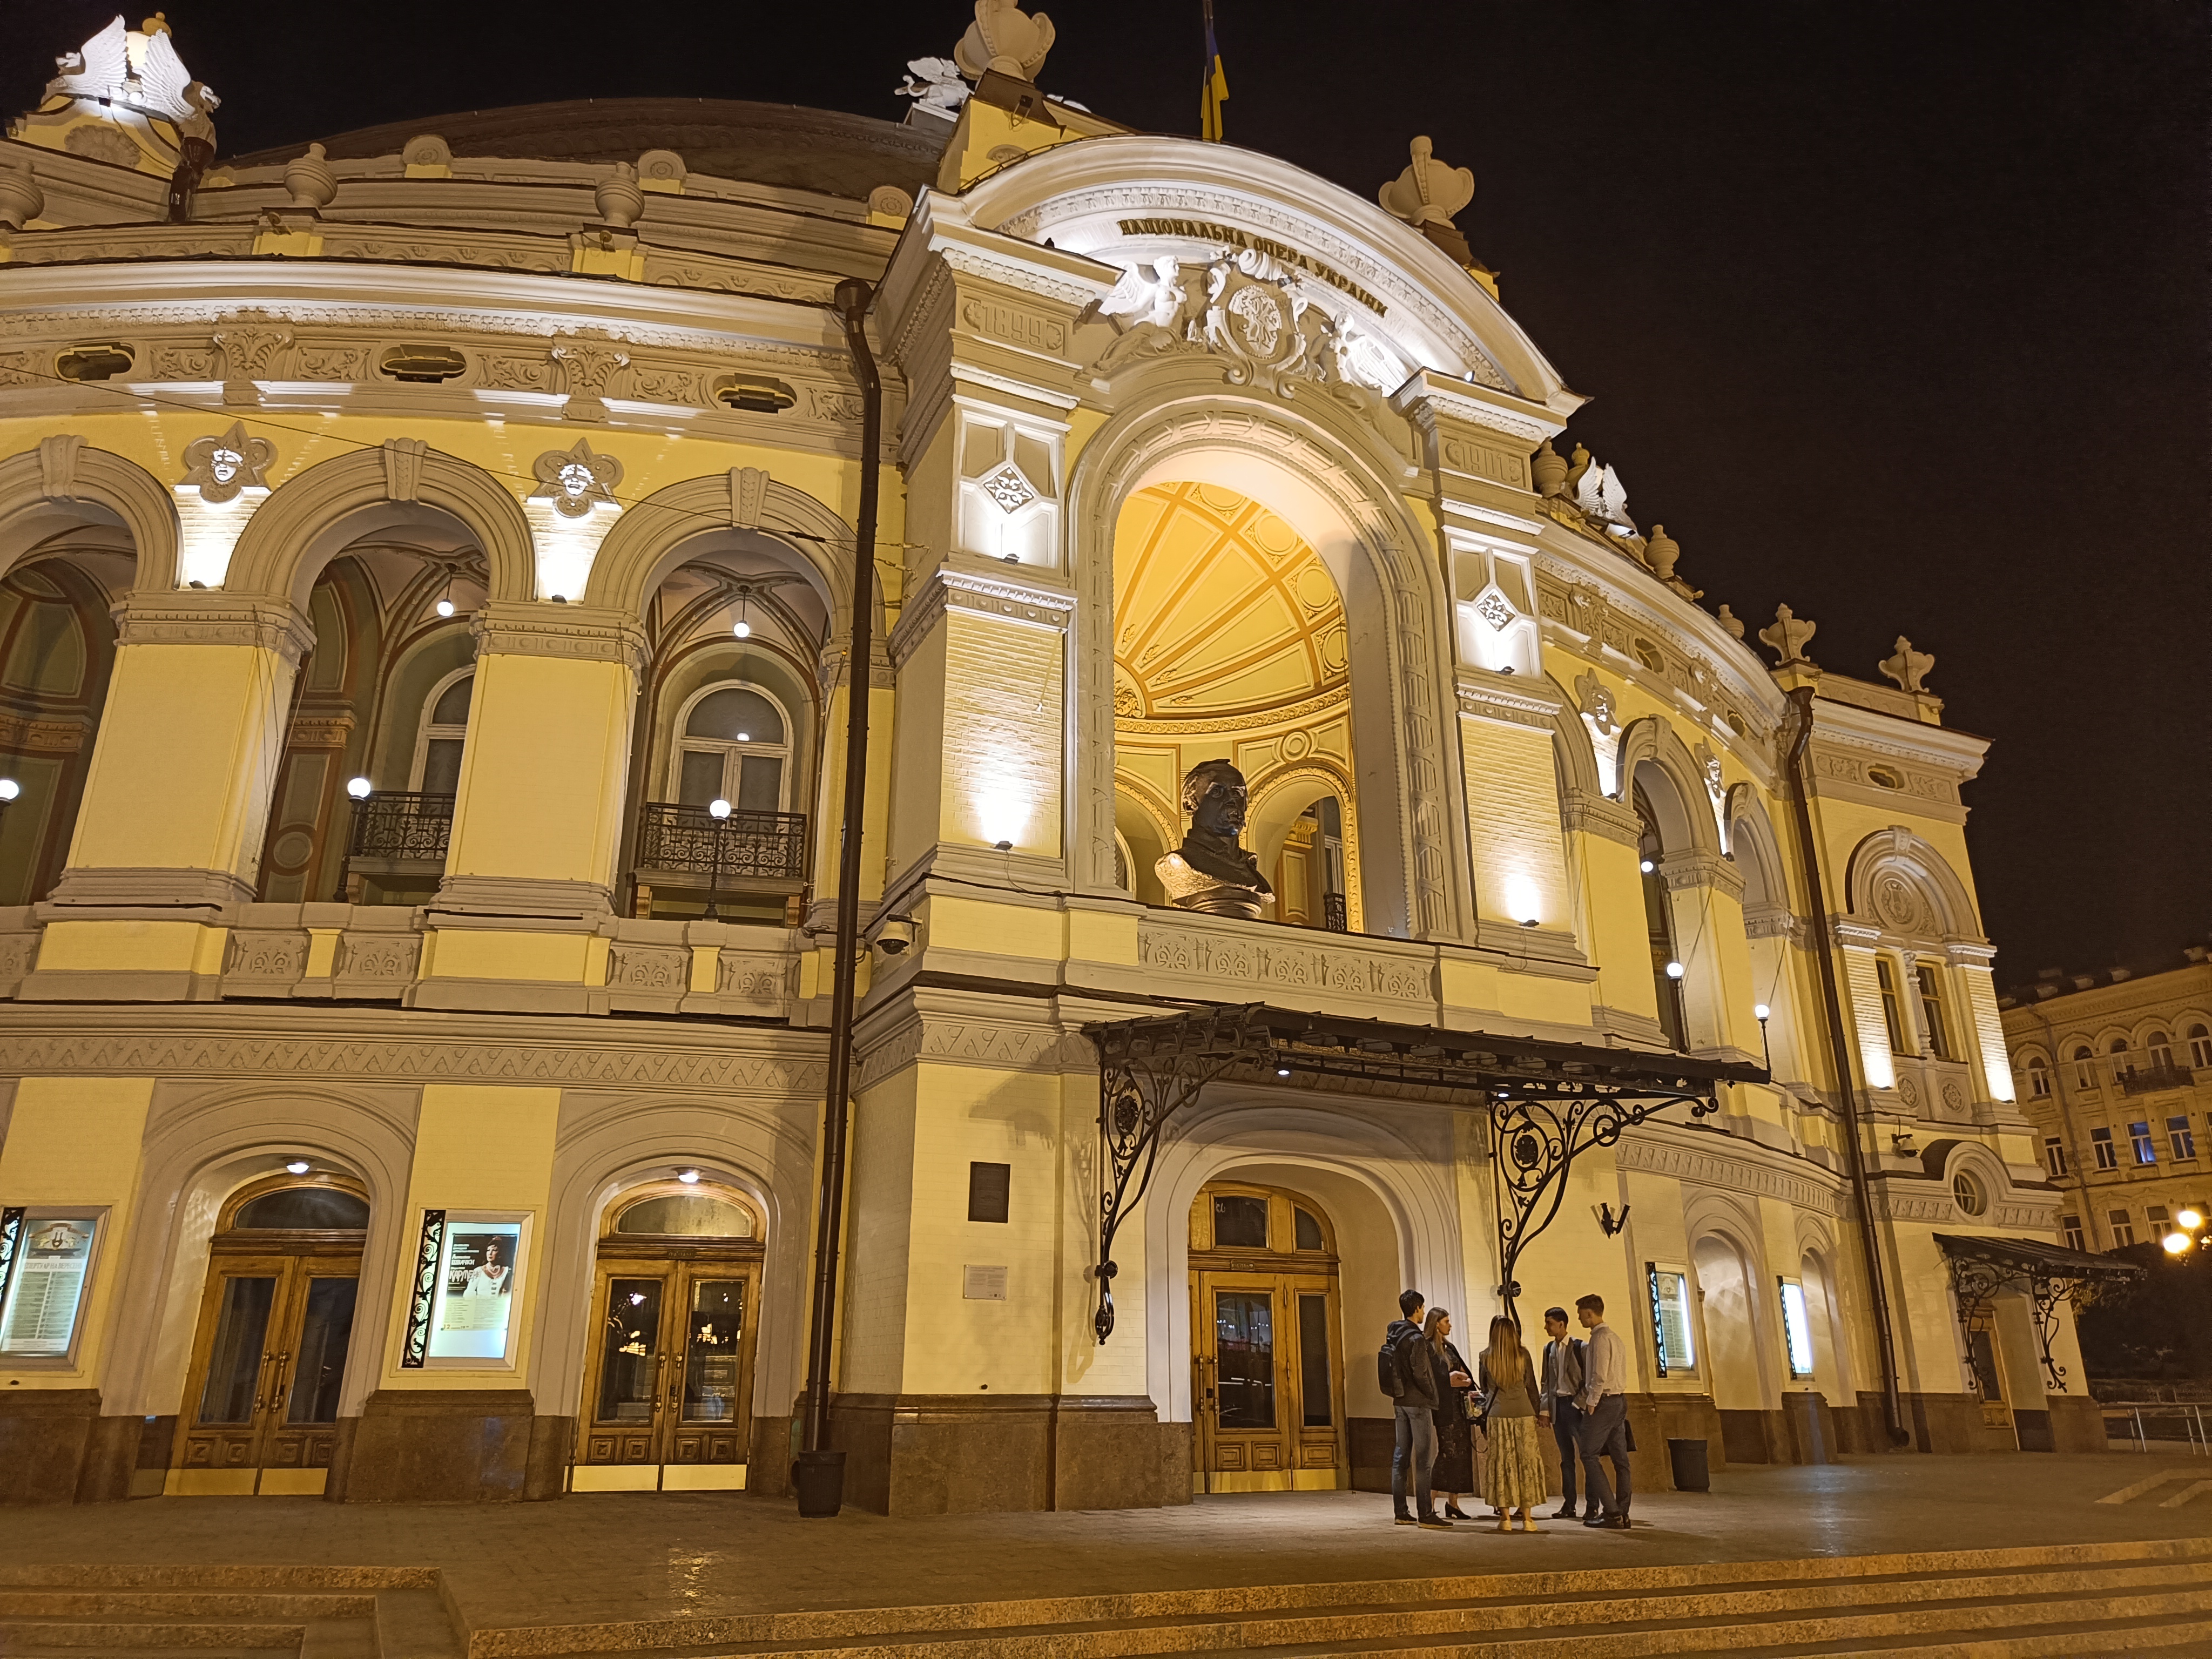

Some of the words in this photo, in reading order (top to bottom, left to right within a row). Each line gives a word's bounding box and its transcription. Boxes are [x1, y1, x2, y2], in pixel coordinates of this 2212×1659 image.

[1117, 219, 1247, 248] НАЦІОНАЛЬНА
[1253, 238, 1308, 269] ОПЕРА
[982, 306, 1045, 348] 1899
[1461, 446, 1507, 481] 1901
